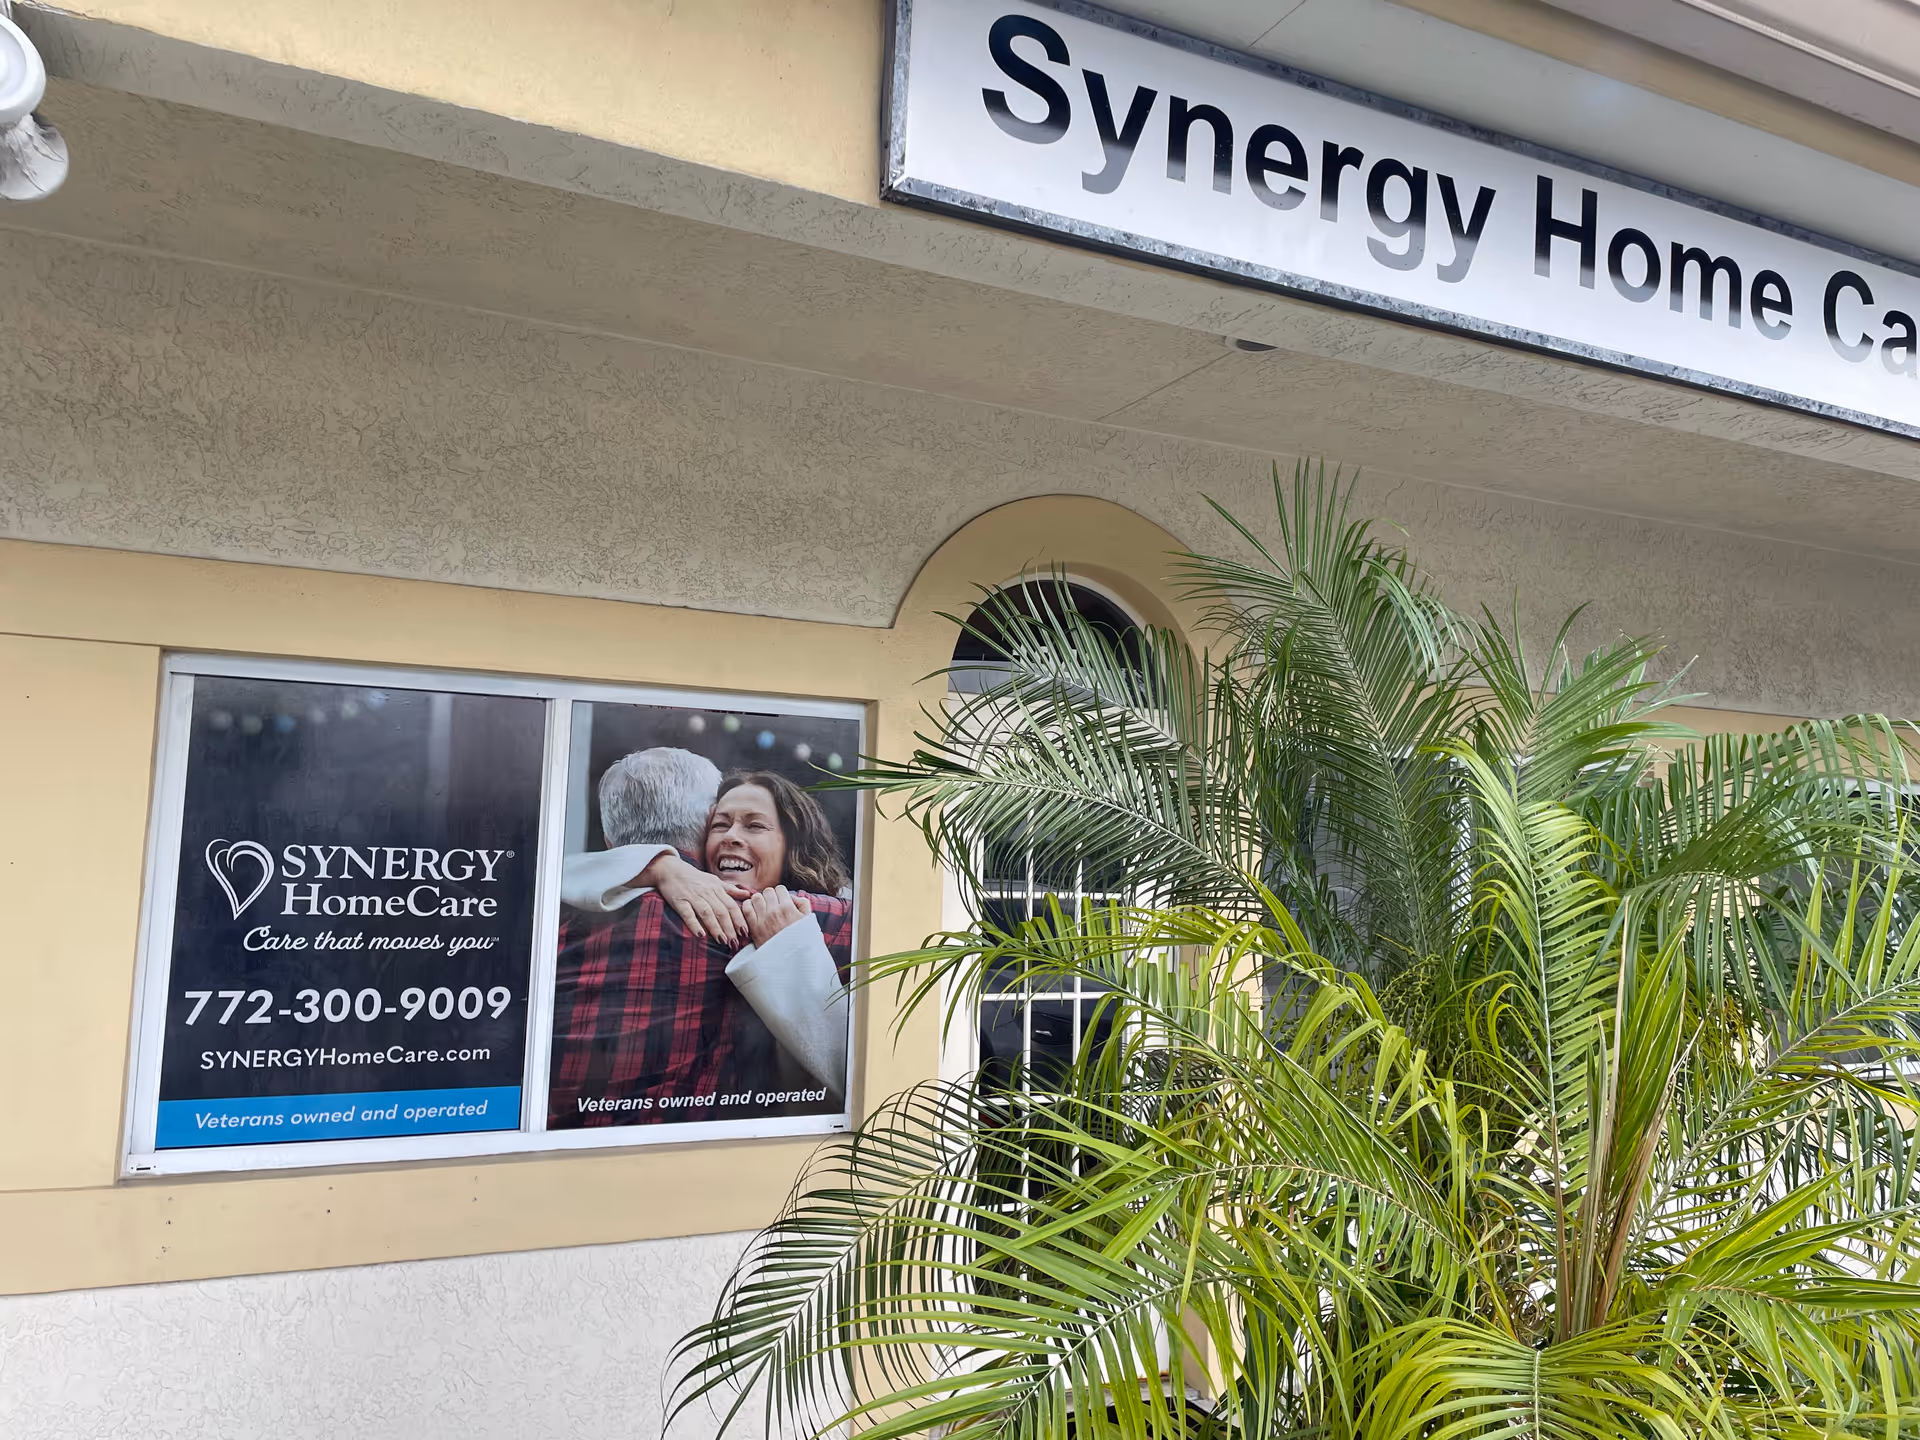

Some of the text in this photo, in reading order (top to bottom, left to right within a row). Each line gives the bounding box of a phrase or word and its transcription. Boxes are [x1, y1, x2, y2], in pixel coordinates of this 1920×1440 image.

[982, 14, 1918, 380] Synergy Home Ca
[280, 882, 498, 917] HomeCare
[243, 925, 309, 952] Care
[313, 930, 364, 950] that
[368, 934, 444, 951] moves
[184, 986, 512, 1026] 772-300-9009
[200, 1045, 491, 1071] SYNERGYHomeCare.com
[195, 1099, 488, 1130] Veterans owned and operated
[577, 1086, 827, 1113] Veterans owned and operated
